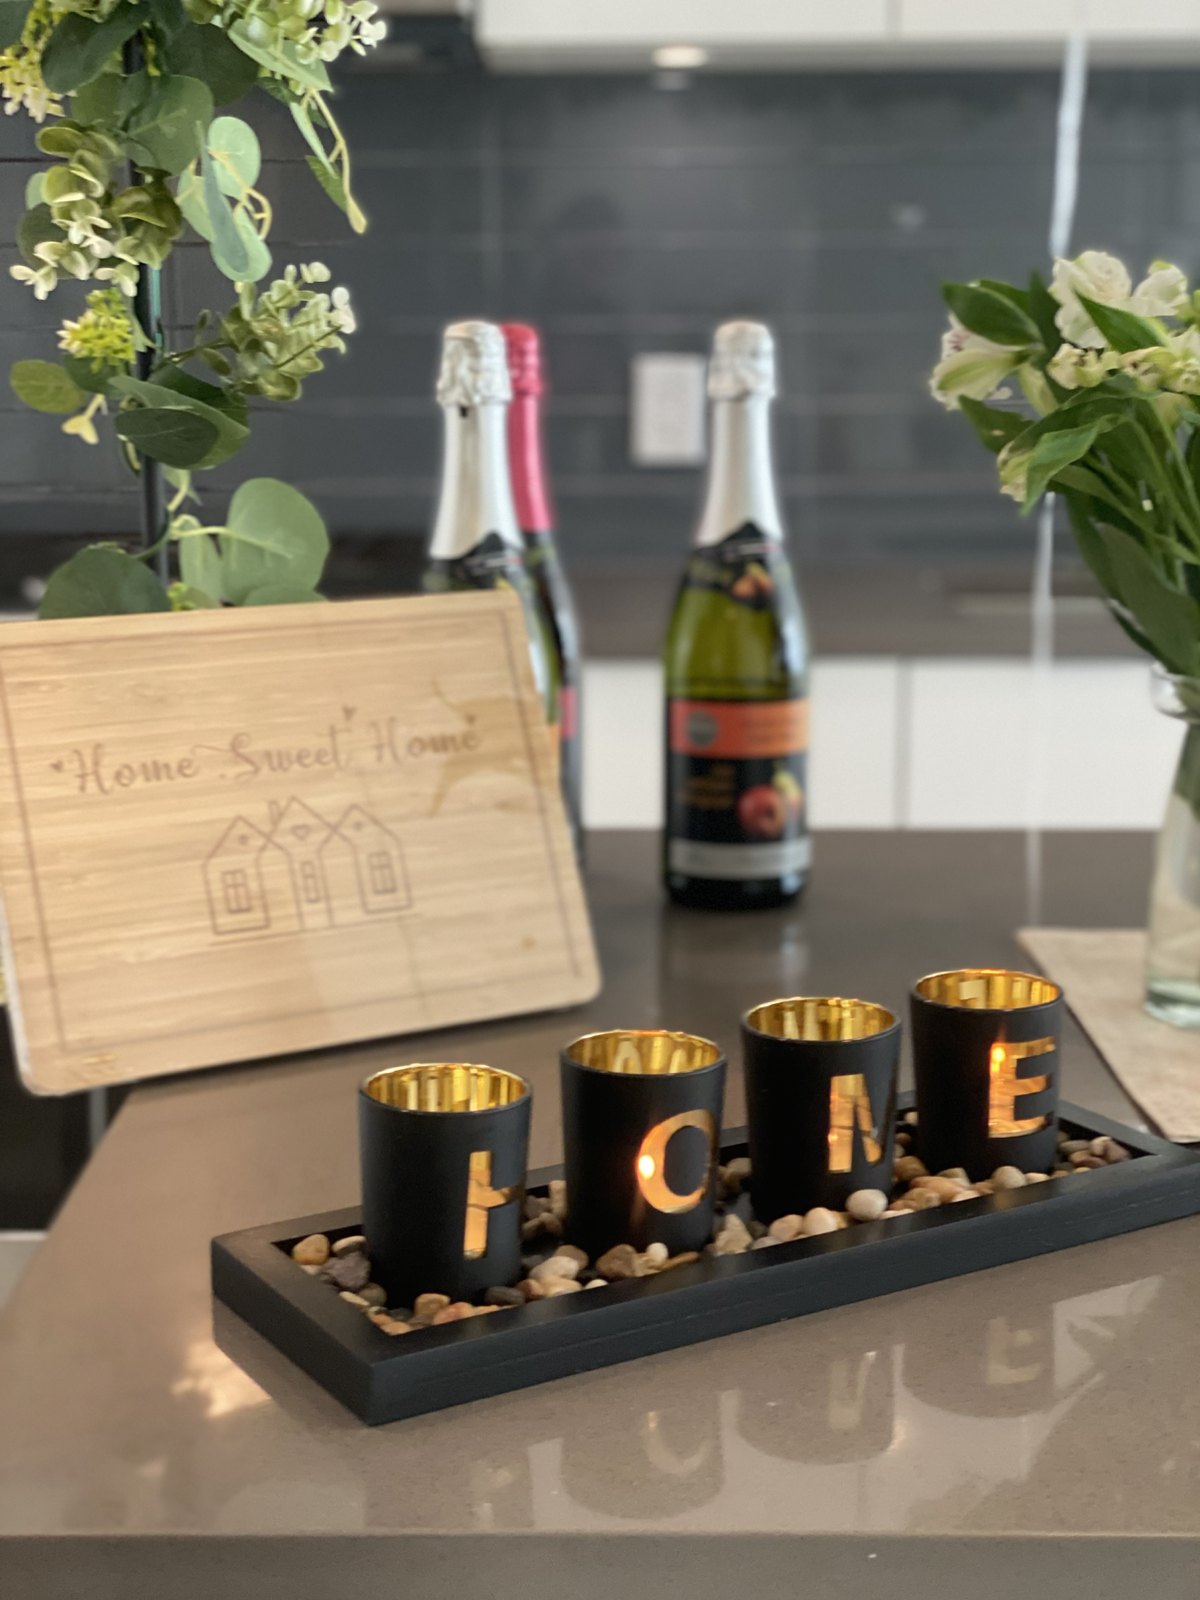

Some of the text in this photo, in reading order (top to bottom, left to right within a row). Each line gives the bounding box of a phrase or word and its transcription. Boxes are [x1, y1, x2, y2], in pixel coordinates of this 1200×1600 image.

[73, 717, 481, 795] Home Sweet Home
